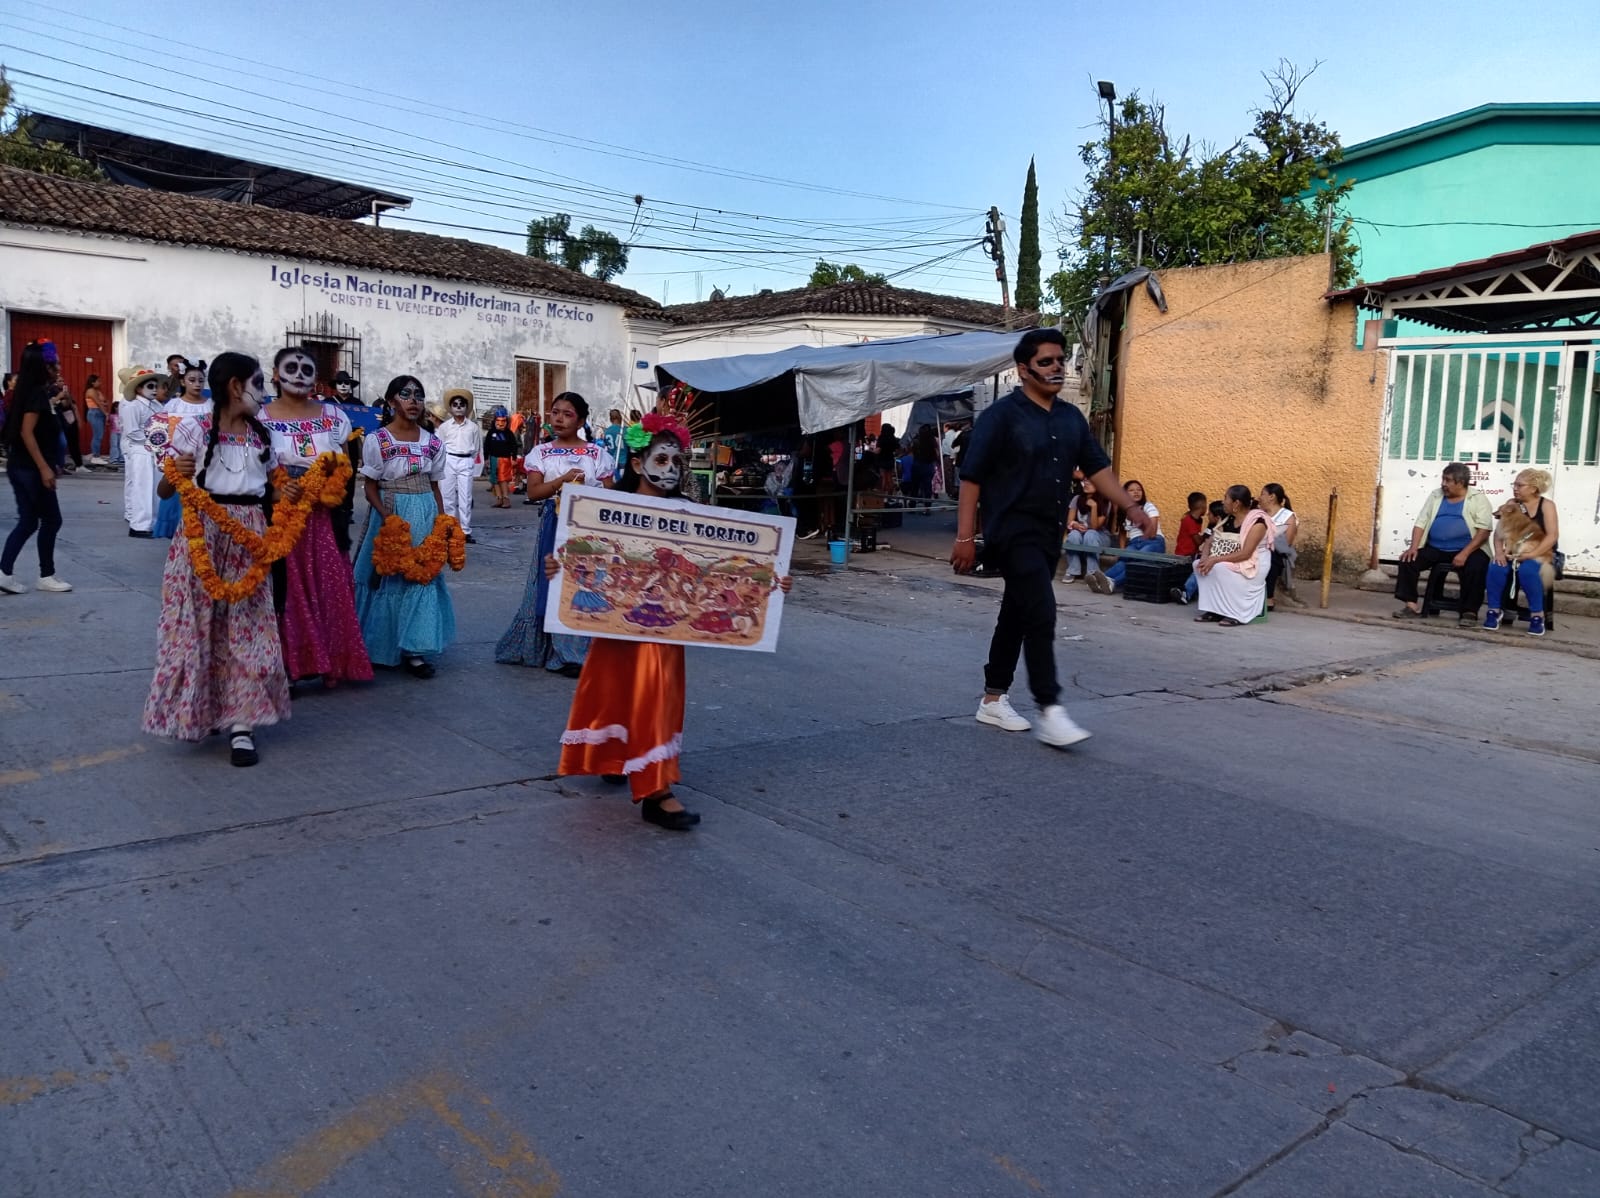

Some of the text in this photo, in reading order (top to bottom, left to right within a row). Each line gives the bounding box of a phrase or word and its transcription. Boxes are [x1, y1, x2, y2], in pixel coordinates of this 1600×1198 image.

[271, 265, 594, 323] Iglesia Nacional Presbiteriana de México
[377, 299, 392, 310] EL
[598, 507, 759, 545] BAILE DEL TORITO
